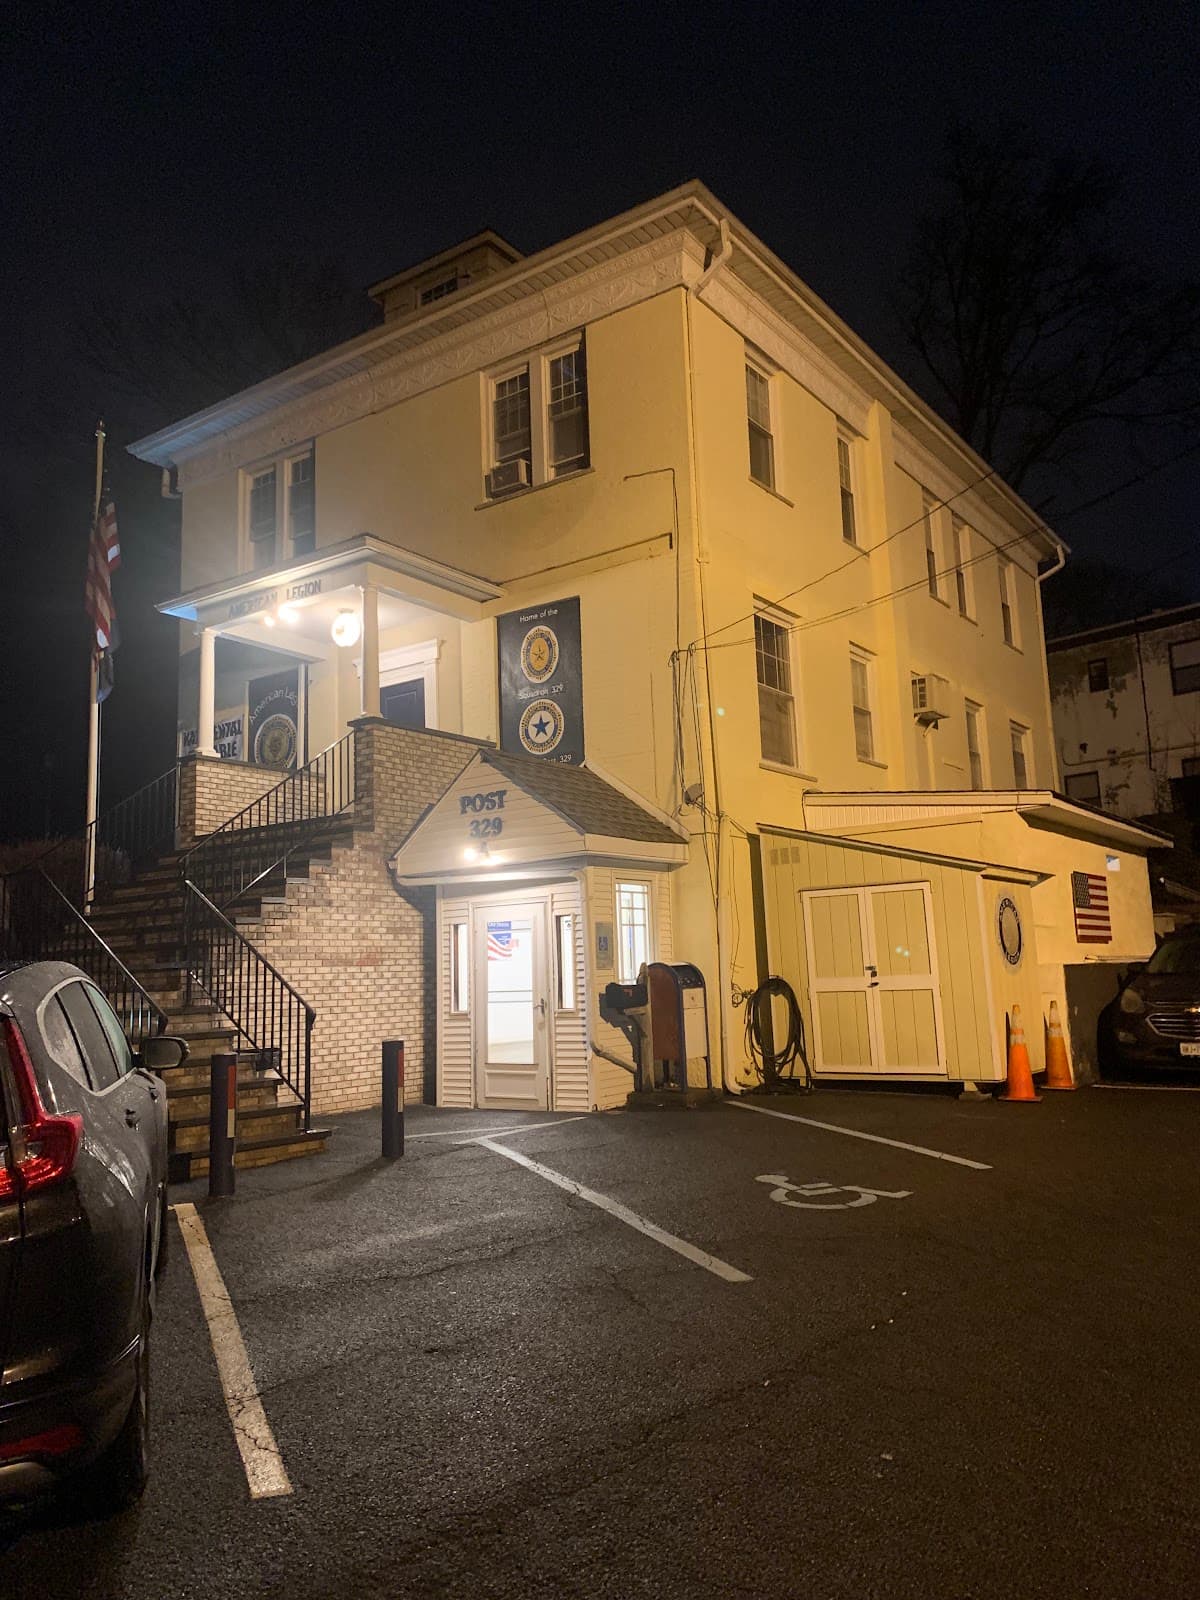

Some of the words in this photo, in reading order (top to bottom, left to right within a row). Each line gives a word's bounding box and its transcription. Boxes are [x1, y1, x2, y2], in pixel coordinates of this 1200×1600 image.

[286, 579, 321, 600] LEGION
[519, 613, 538, 623] Home
[539, 608, 547, 618] of
[547, 608, 559, 616] the
[551, 683, 564, 694] 329
[214, 719, 242, 740] ENTAL
[559, 754, 572, 764] 329
[460, 790, 507, 815] POST
[470, 817, 503, 838] 329
